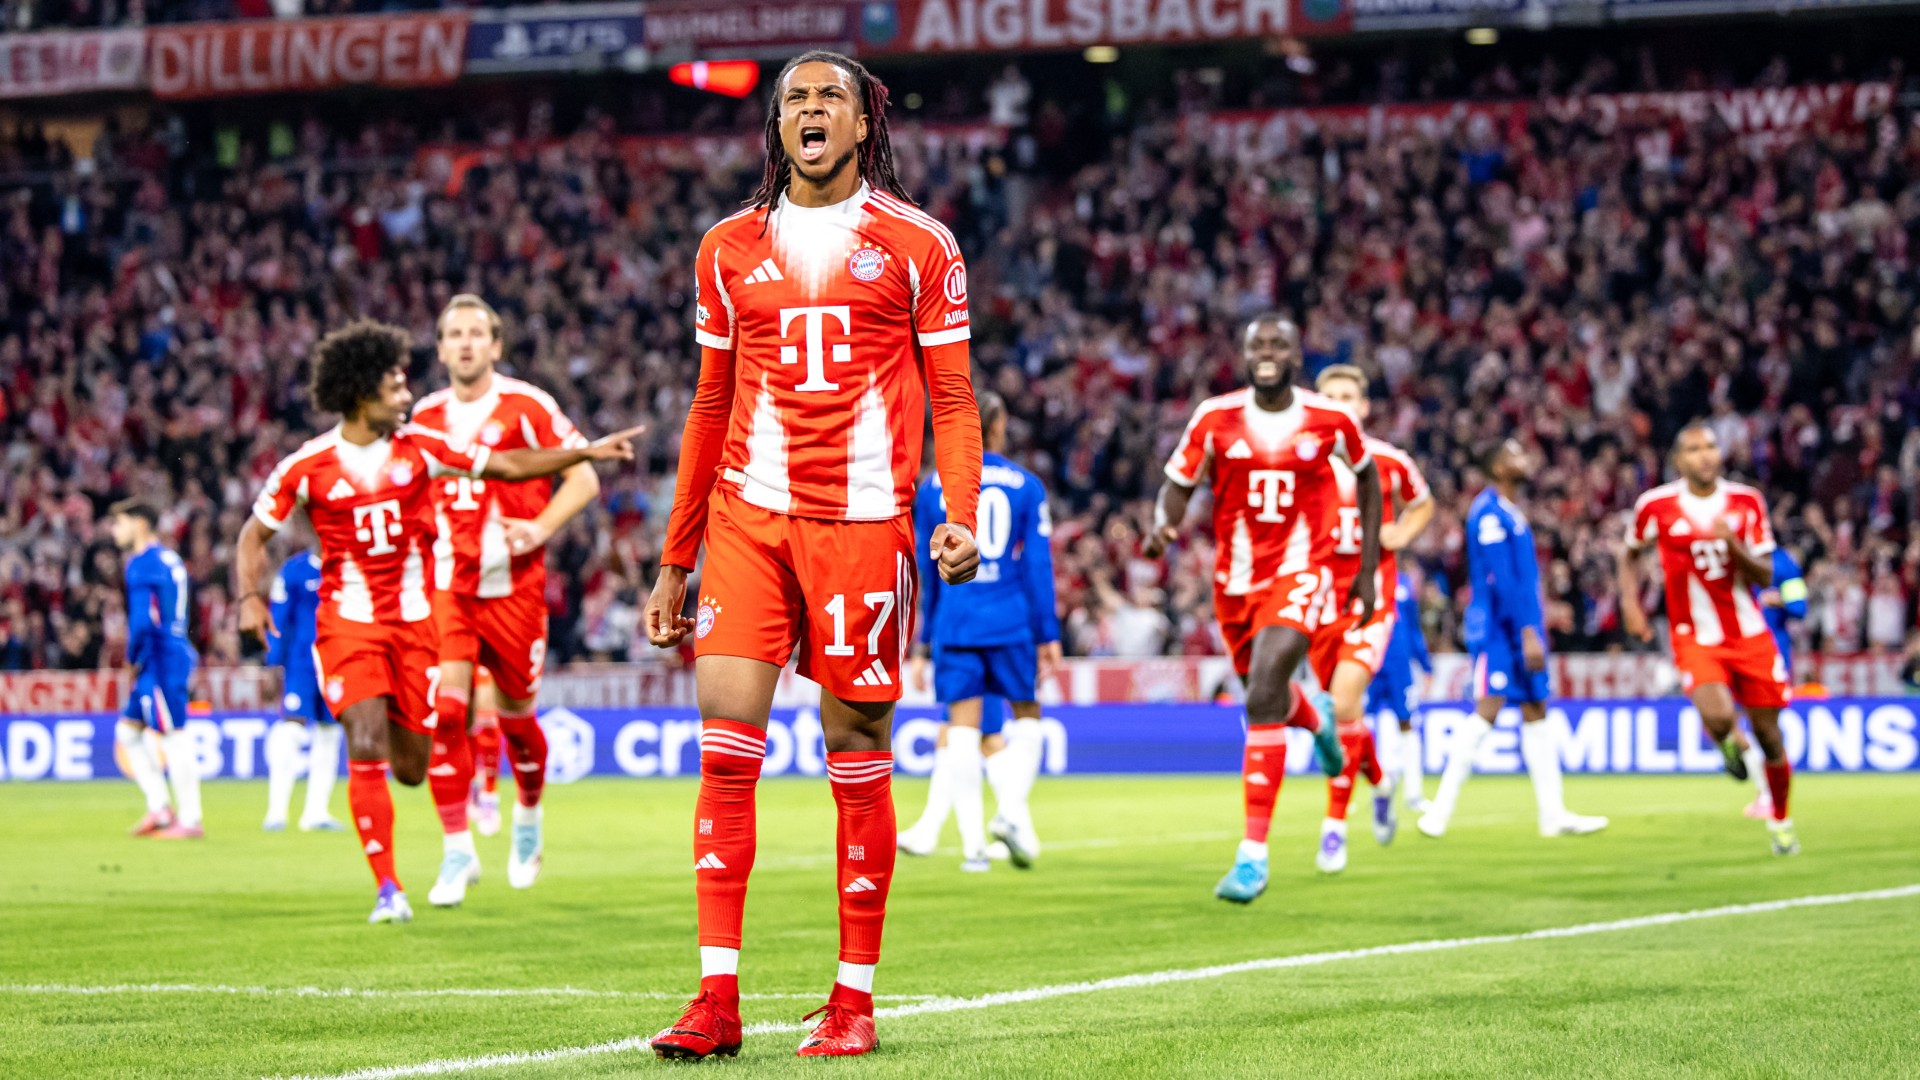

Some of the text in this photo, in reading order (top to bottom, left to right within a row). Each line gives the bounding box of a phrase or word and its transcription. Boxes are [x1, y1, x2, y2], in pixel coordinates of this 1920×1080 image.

[152, 17, 464, 93] DILLINGEN
[912, 0, 1290, 50] AIGLSBACH
[824, 590, 895, 656] 17
[0, 719, 94, 779] DE
[1548, 705, 1918, 772] MILLONS
